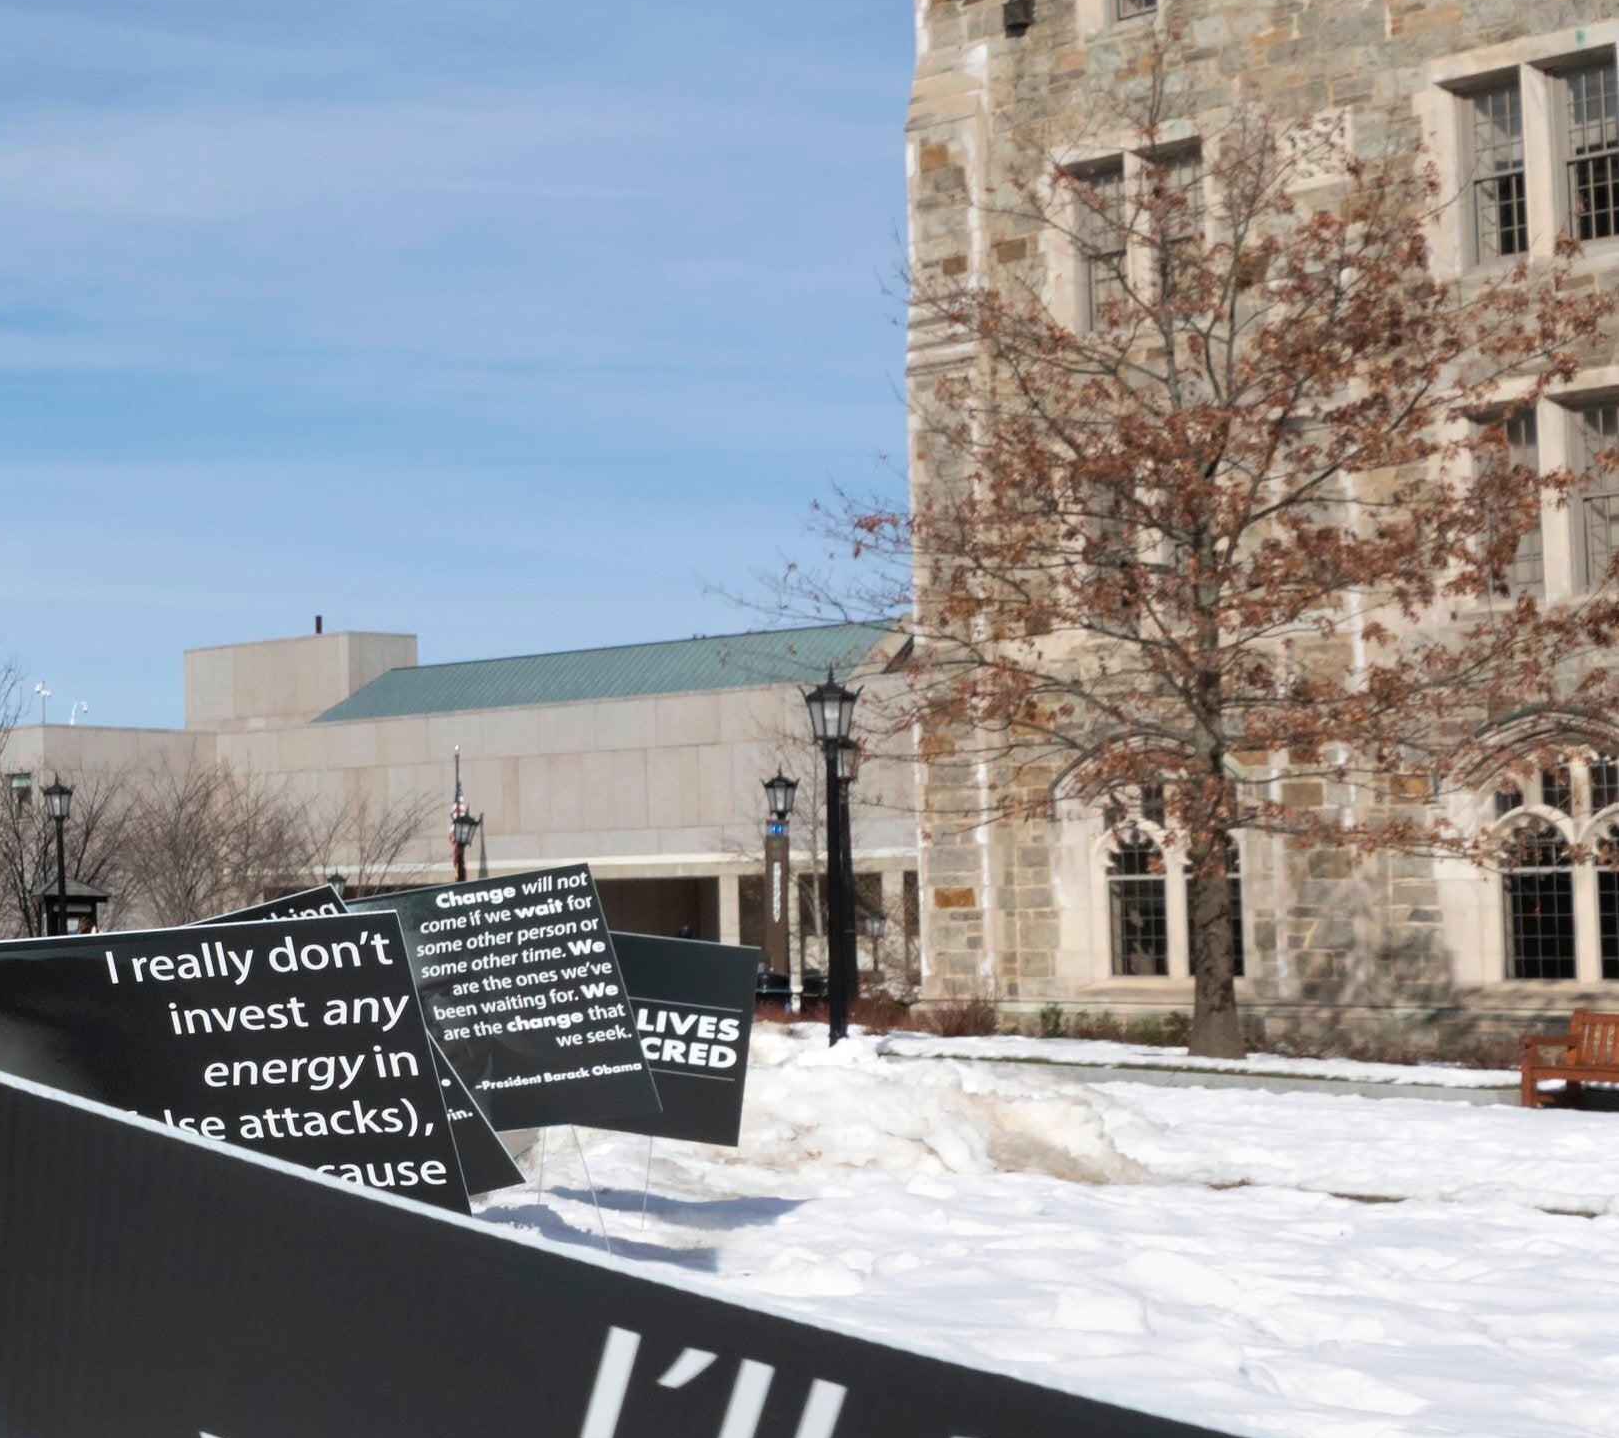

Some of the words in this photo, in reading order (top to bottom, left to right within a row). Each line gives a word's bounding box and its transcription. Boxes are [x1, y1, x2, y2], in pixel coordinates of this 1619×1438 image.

[435, 886, 516, 908] Change
[521, 874, 552, 895] will
[556, 871, 588, 889] not
[419, 916, 466, 934] come
[468, 910, 484, 927] if
[483, 909, 512, 924] we
[514, 899, 563, 919] wait
[566, 894, 593, 911] for
[415, 939, 462, 957] some
[465, 929, 513, 950] other
[516, 920, 577, 945] person
[579, 916, 600, 932] or
[105, 950, 120, 985] I
[131, 940, 253, 985] really
[268, 930, 393, 972] don't
[420, 960, 467, 979] some
[470, 951, 518, 971] other
[521, 944, 566, 964] time.
[567, 938, 606, 956] We
[451, 980, 480, 996] are
[481, 971, 512, 992] the
[515, 970, 558, 987] ones
[559, 961, 612, 980] we've
[168, 996, 308, 1034] invest
[322, 994, 409, 1032] any
[433, 1000, 478, 1021] been
[479, 989, 547, 1013] waiting
[548, 987, 579, 1004] for.
[580, 981, 619, 999] We
[442, 1025, 471, 1041] are
[472, 1017, 503, 1036] the
[506, 1010, 584, 1033] change
[586, 1002, 626, 1020] that
[555, 1032, 583, 1048] we
[586, 1024, 632, 1043] seek.
[636, 1007, 740, 1042] LIVES
[203, 1054, 365, 1090] energy
[372, 1045, 419, 1078] in
[543, 1068, 590, 1083] Barack
[591, 1061, 643, 1077] Obama
[239, 1097, 434, 1140] attacks),
